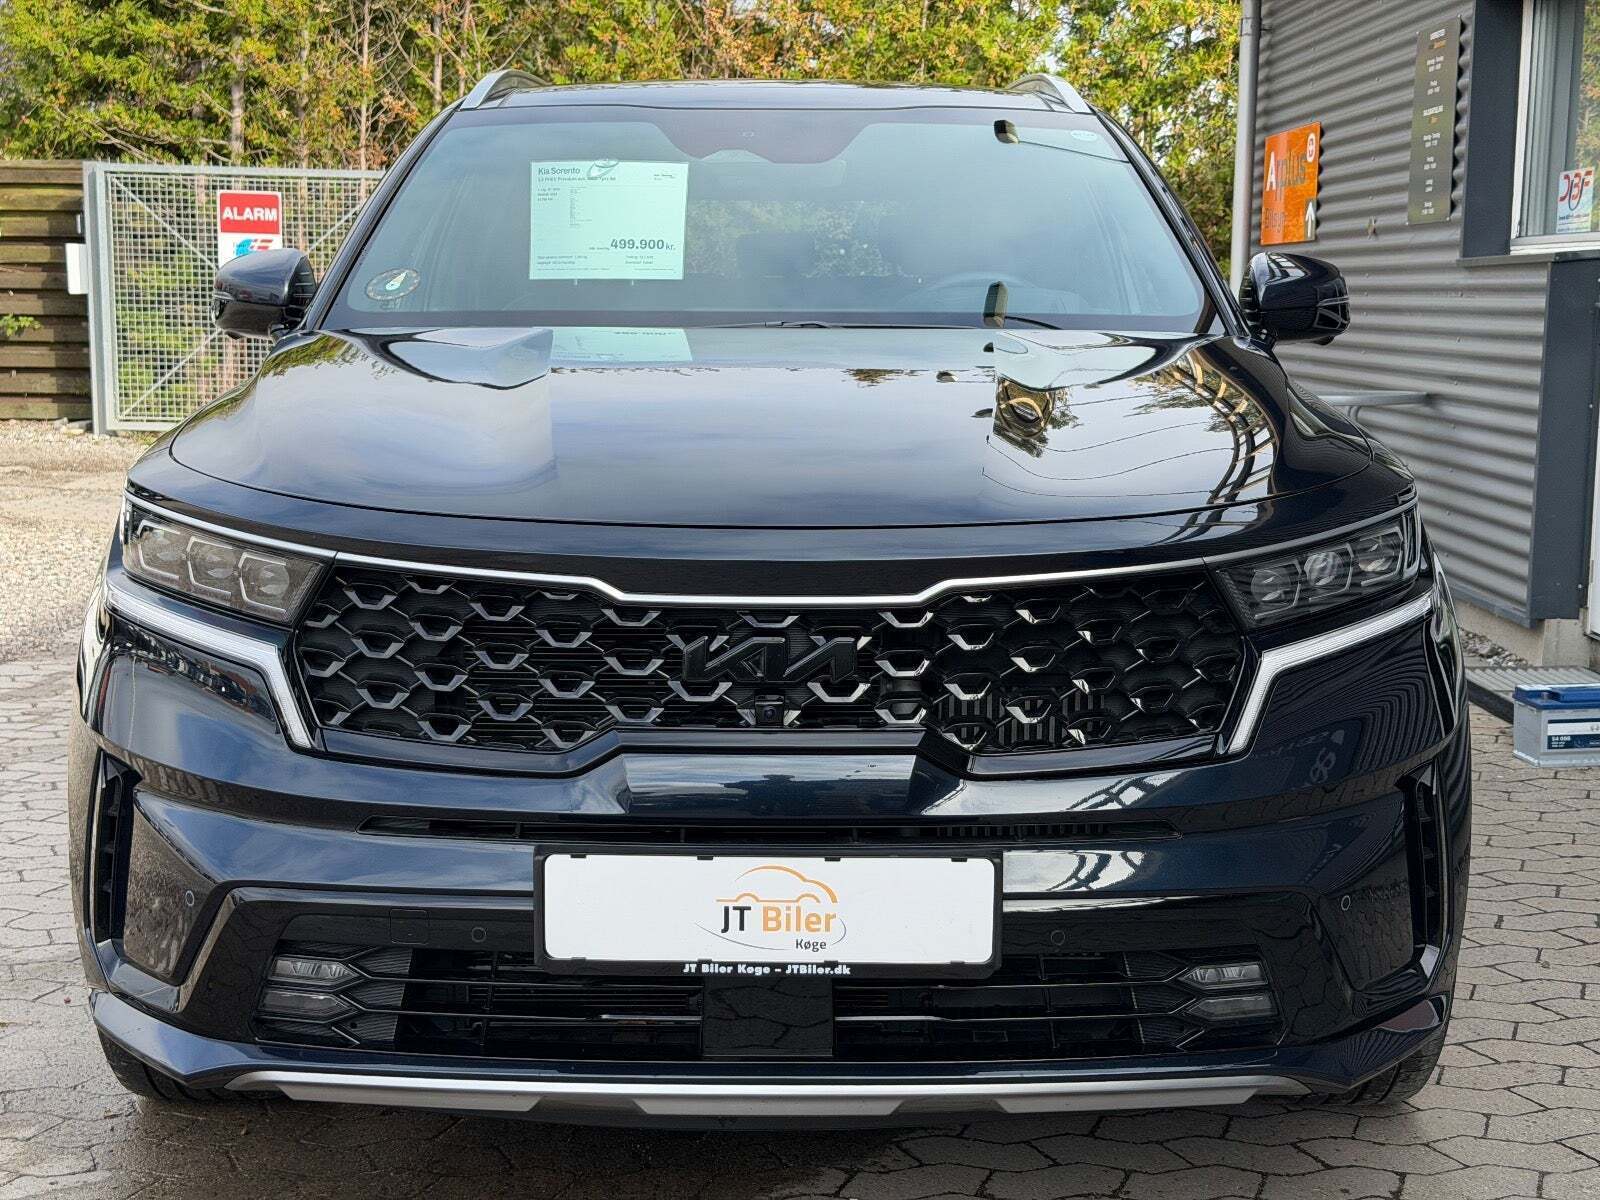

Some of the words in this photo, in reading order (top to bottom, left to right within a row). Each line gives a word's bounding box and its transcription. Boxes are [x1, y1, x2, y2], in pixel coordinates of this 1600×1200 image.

[538, 167, 549, 175] Kia
[551, 167, 581, 175] Sorento
[222, 206, 278, 221] ALARM
[610, 239, 665, 250] 499.900
[665, 242, 676, 251] kr.
[721, 906, 752, 934] JT
[762, 906, 837, 933] Biler
[795, 938, 827, 952] Køge
[683, 963, 698, 974] JT
[701, 963, 733, 975] Biler
[785, 964, 851, 976] JTBiler.dk
